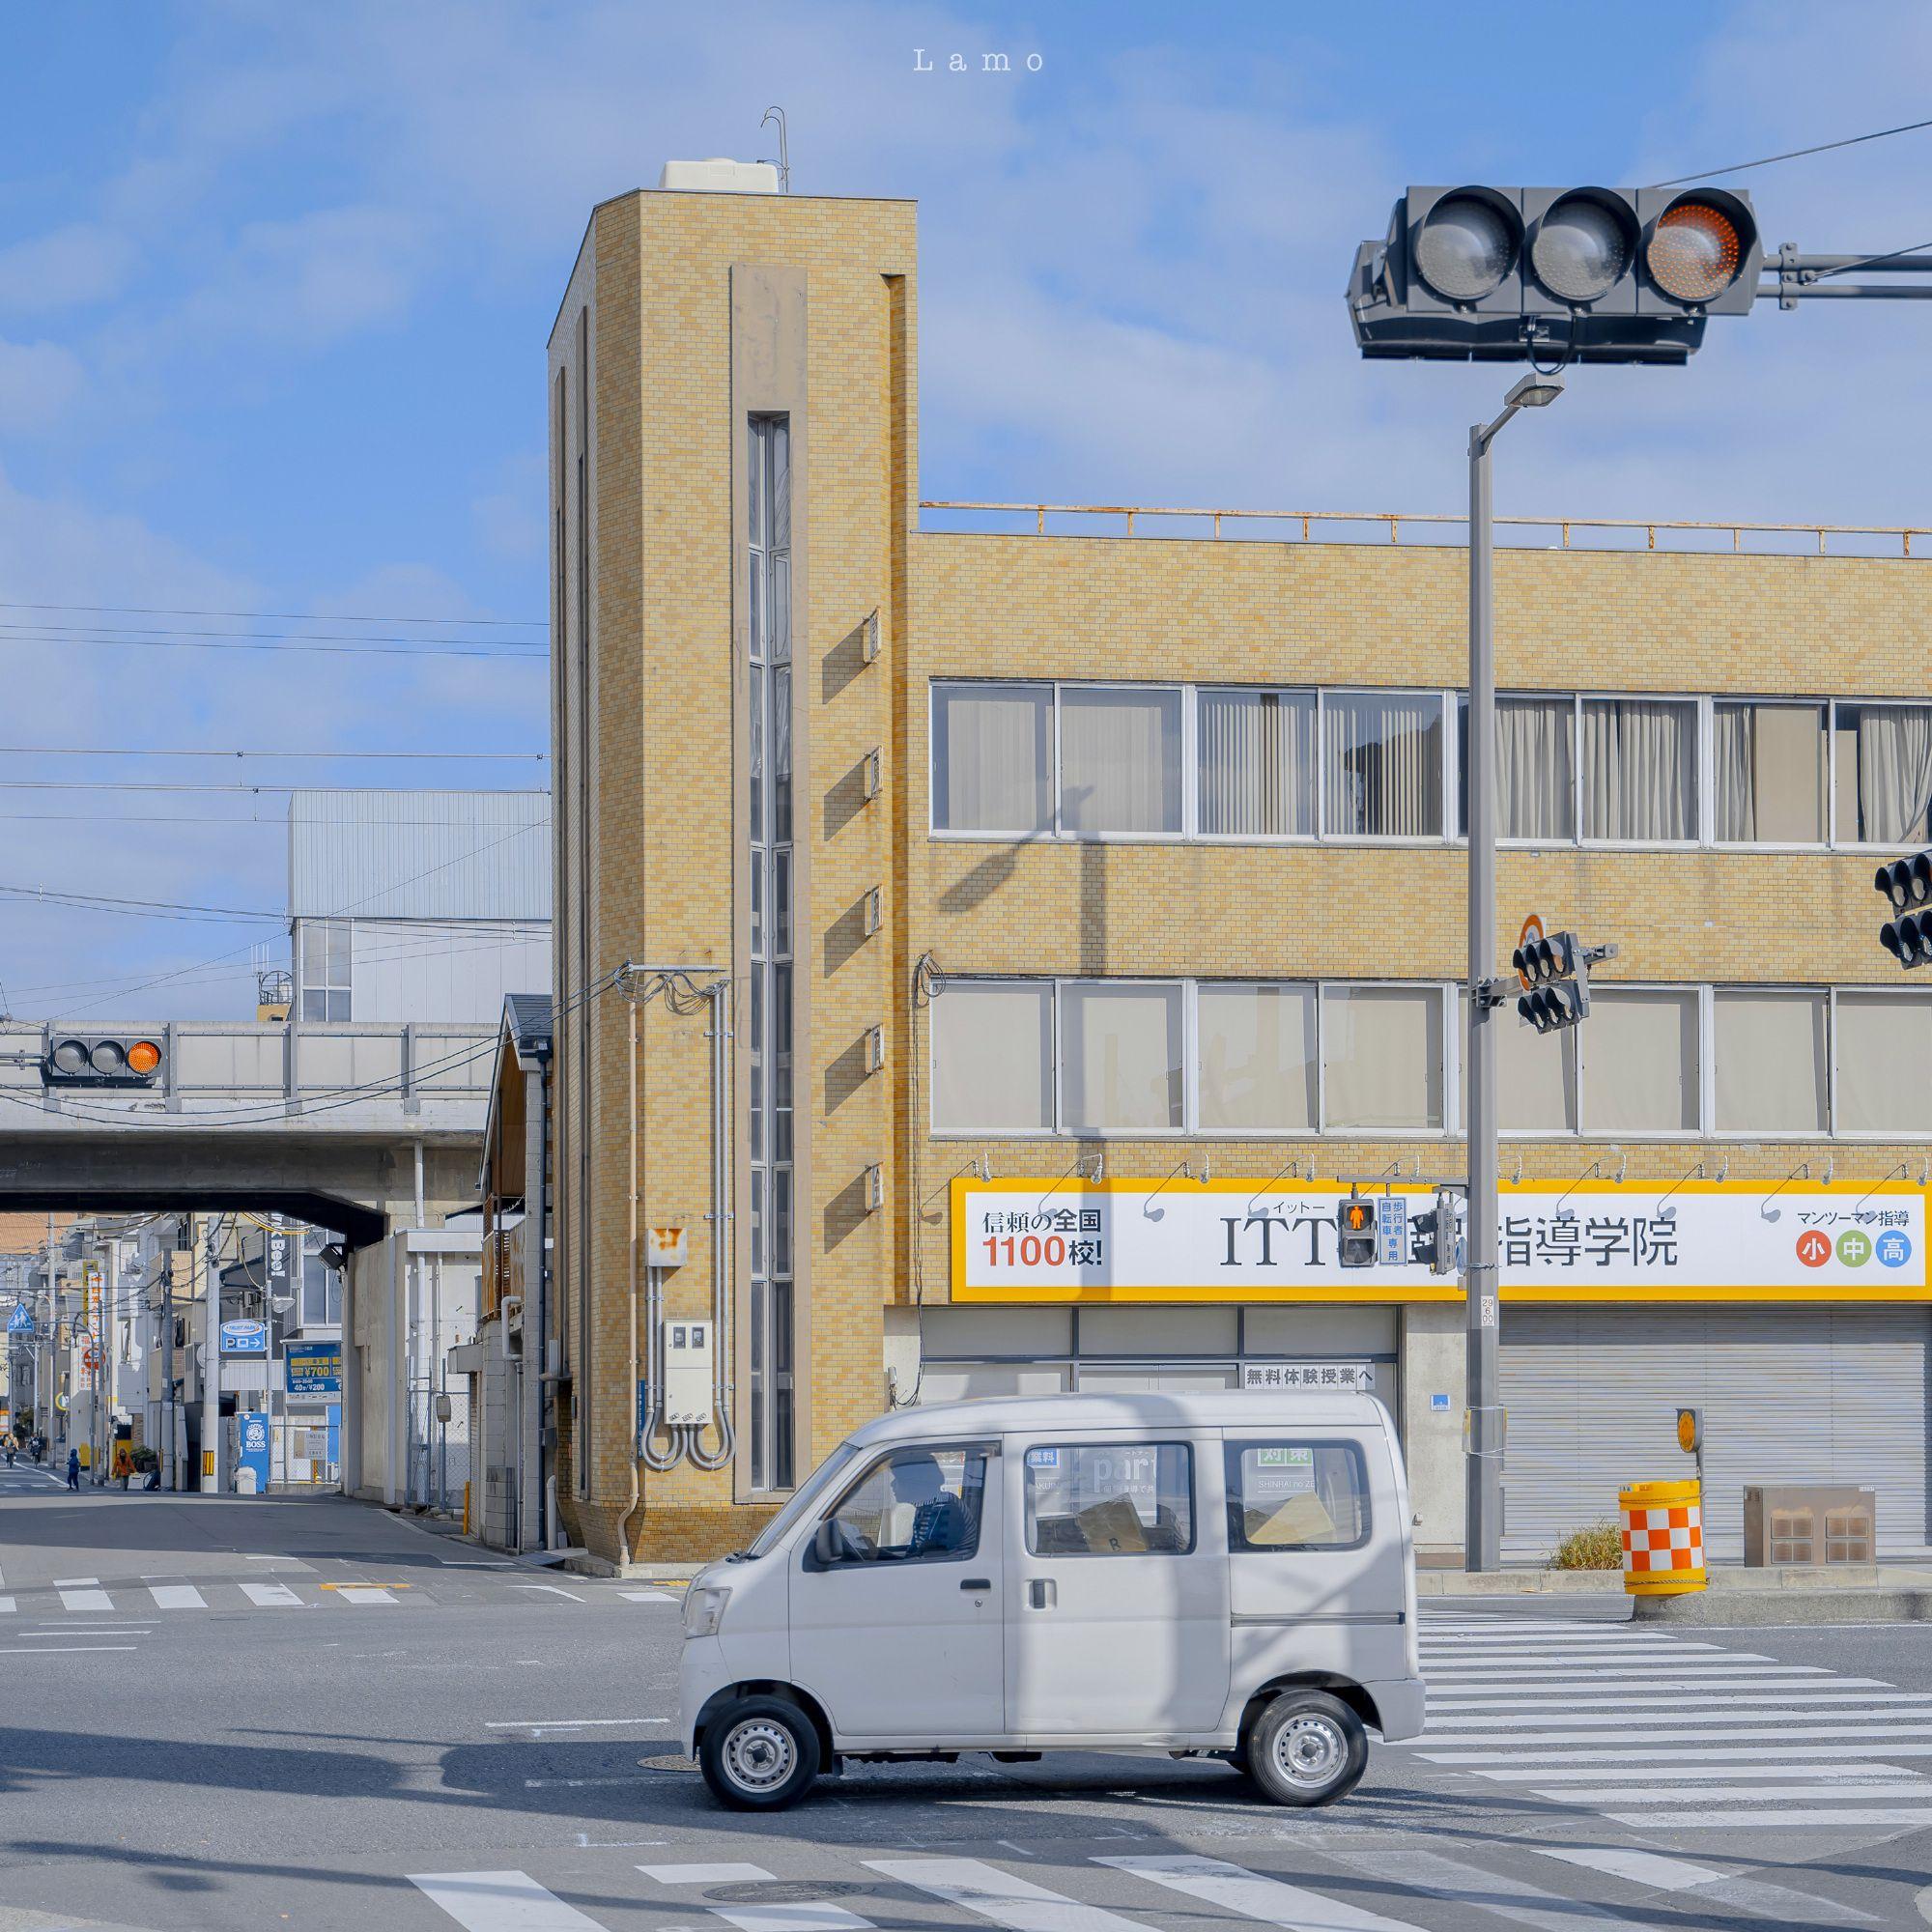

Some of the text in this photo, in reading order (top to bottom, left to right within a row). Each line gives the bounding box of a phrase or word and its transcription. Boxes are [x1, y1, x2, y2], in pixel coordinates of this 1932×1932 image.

[1273, 1201, 1325, 1214] イットー
[982, 1208, 1101, 1234] 信頼の全国
[1381, 1202, 1392, 1236] 自転車
[1393, 1202, 1404, 1236] 歩行者
[1797, 1210, 1910, 1227] マンツーマン指導
[982, 1236, 1102, 1266] 1100校!
[1388, 1237, 1398, 1261] 専用
[1802, 1237, 1905, 1262] 小 中 高
[1482, 1298, 1493, 1307] 29
[1485, 1306, 1491, 1315] 6
[1247, 1368, 1373, 1384] 無料体験授業へ
[1259, 1480, 1291, 1489] SHINRAI
